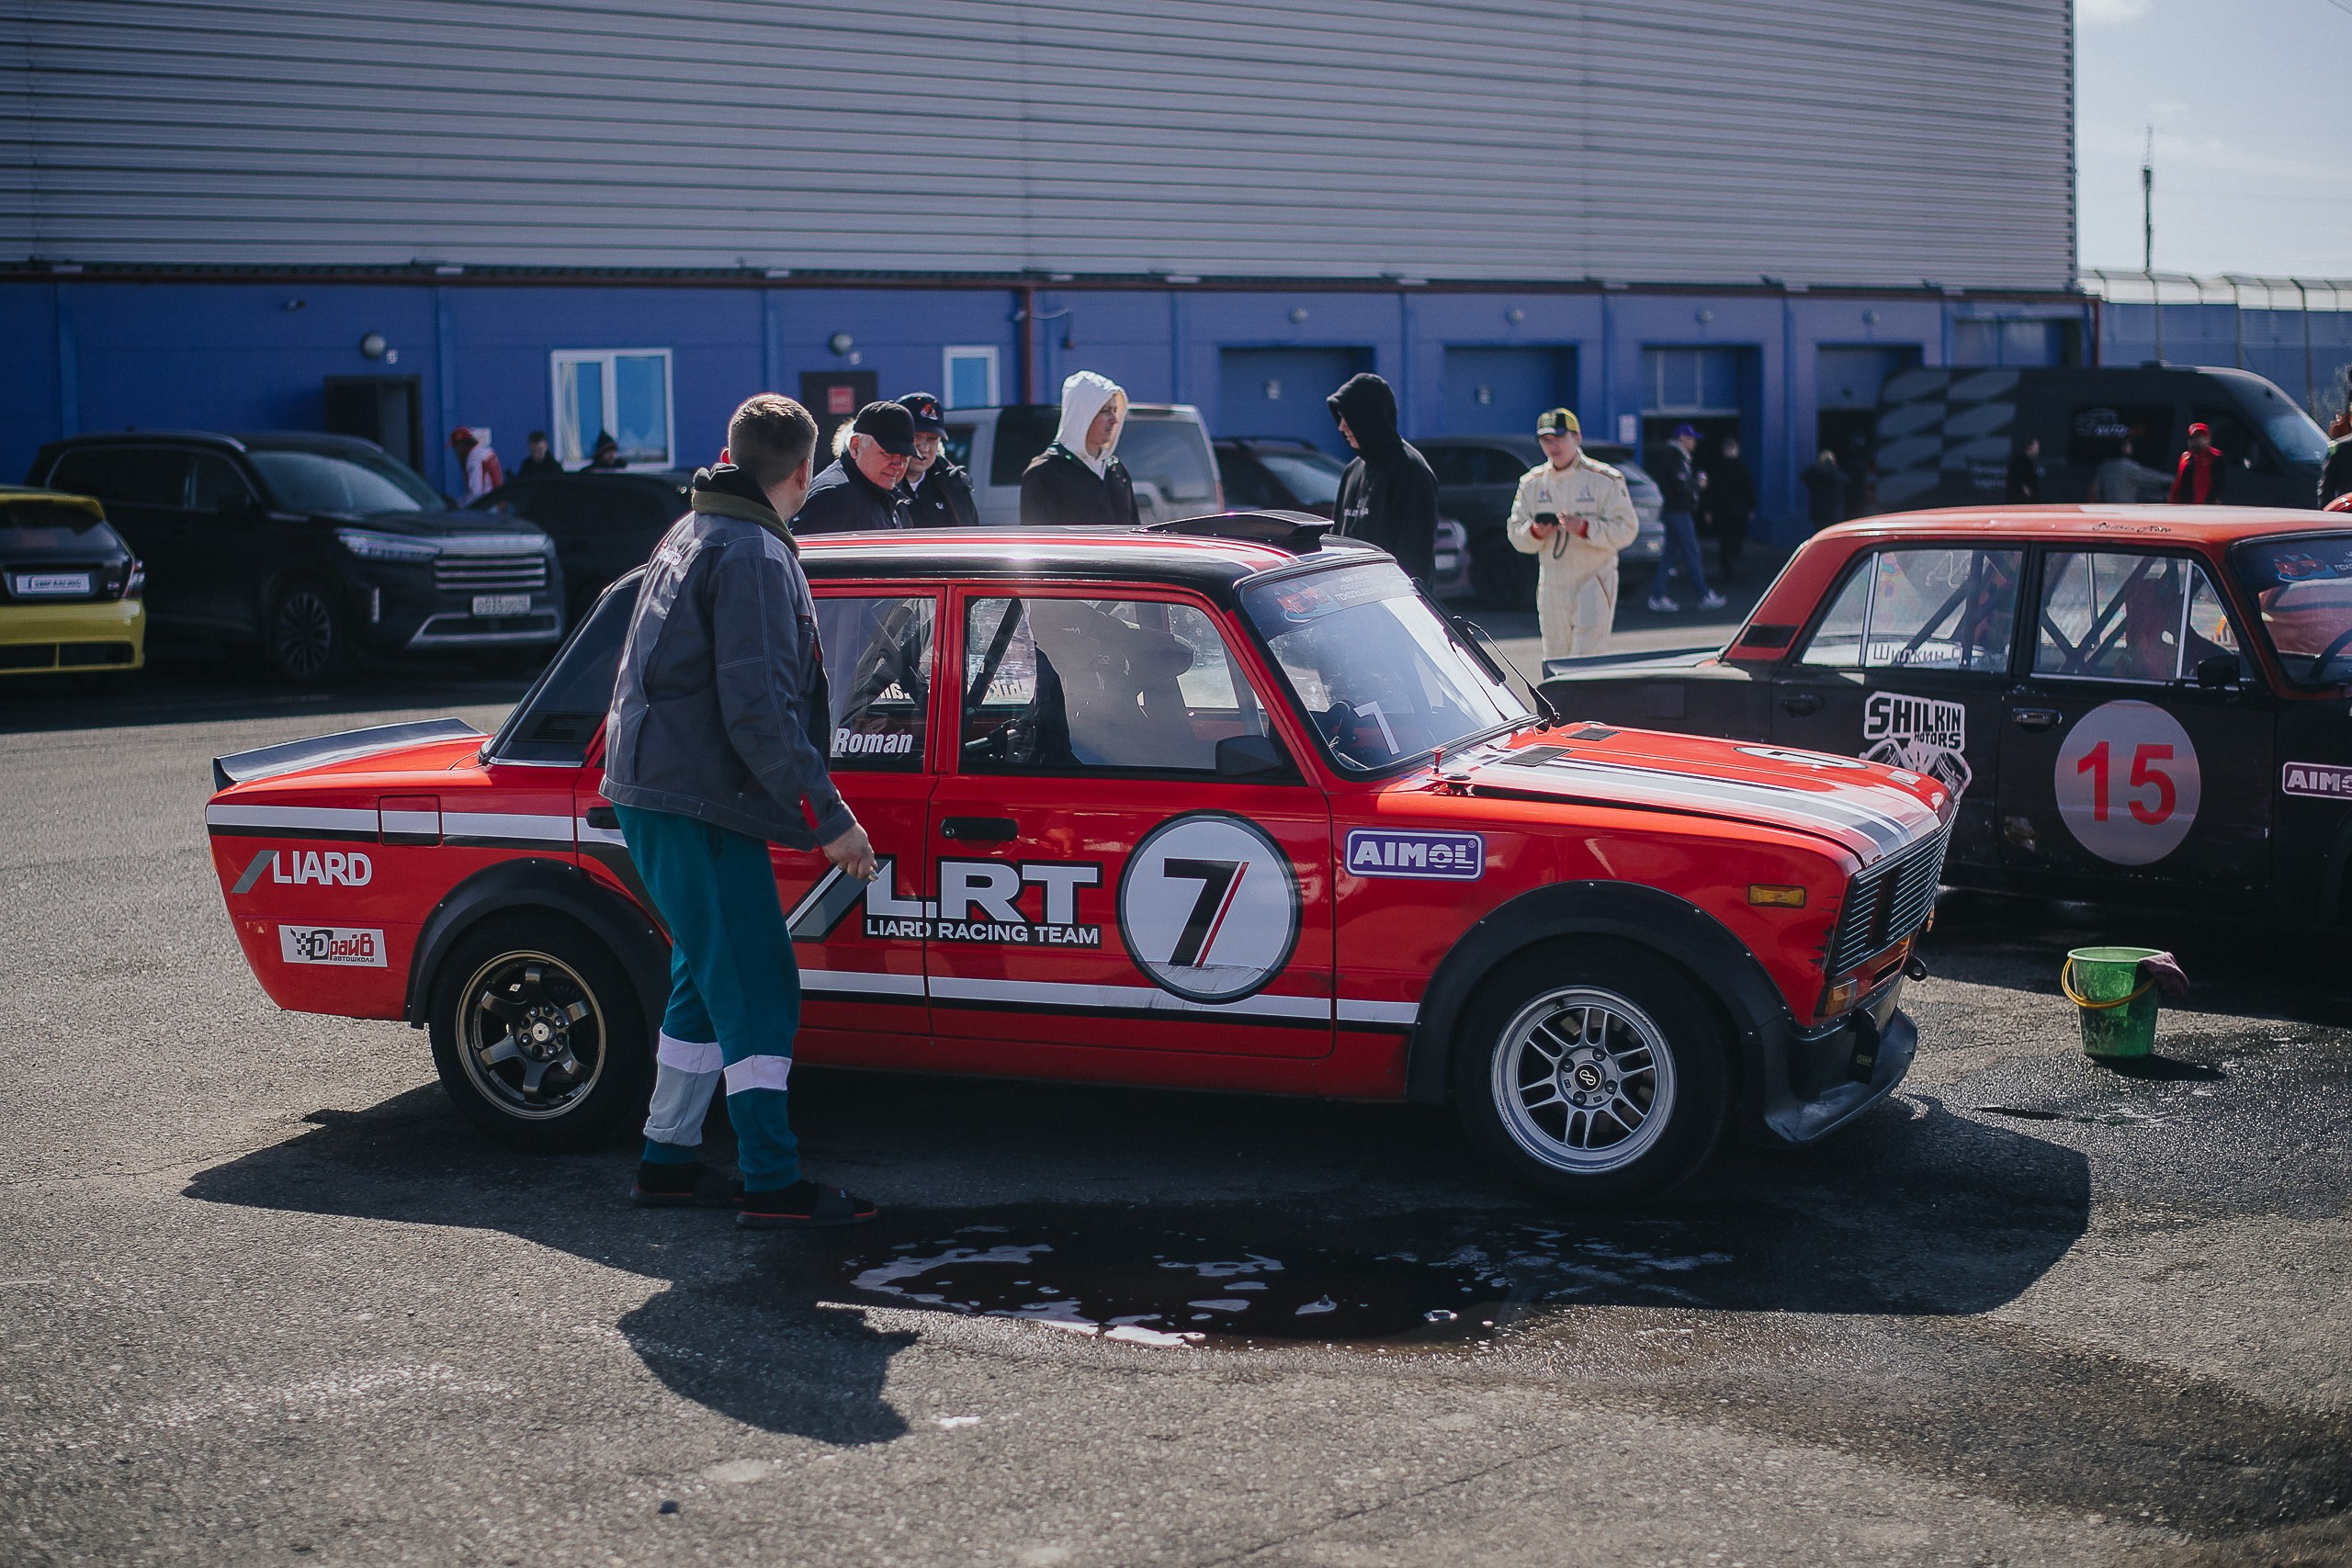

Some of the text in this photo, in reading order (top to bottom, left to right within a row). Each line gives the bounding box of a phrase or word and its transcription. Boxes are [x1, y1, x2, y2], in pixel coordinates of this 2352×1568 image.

[1868, 696, 1962, 734] SHILKIN
[831, 728, 913, 753] Roman
[2076, 740, 2177, 826] 15
[272, 851, 373, 886] LIARD
[866, 860, 1098, 924] LRT
[1163, 857, 1250, 967] 7
[866, 919, 1098, 944] LIARD RACING TEAM
